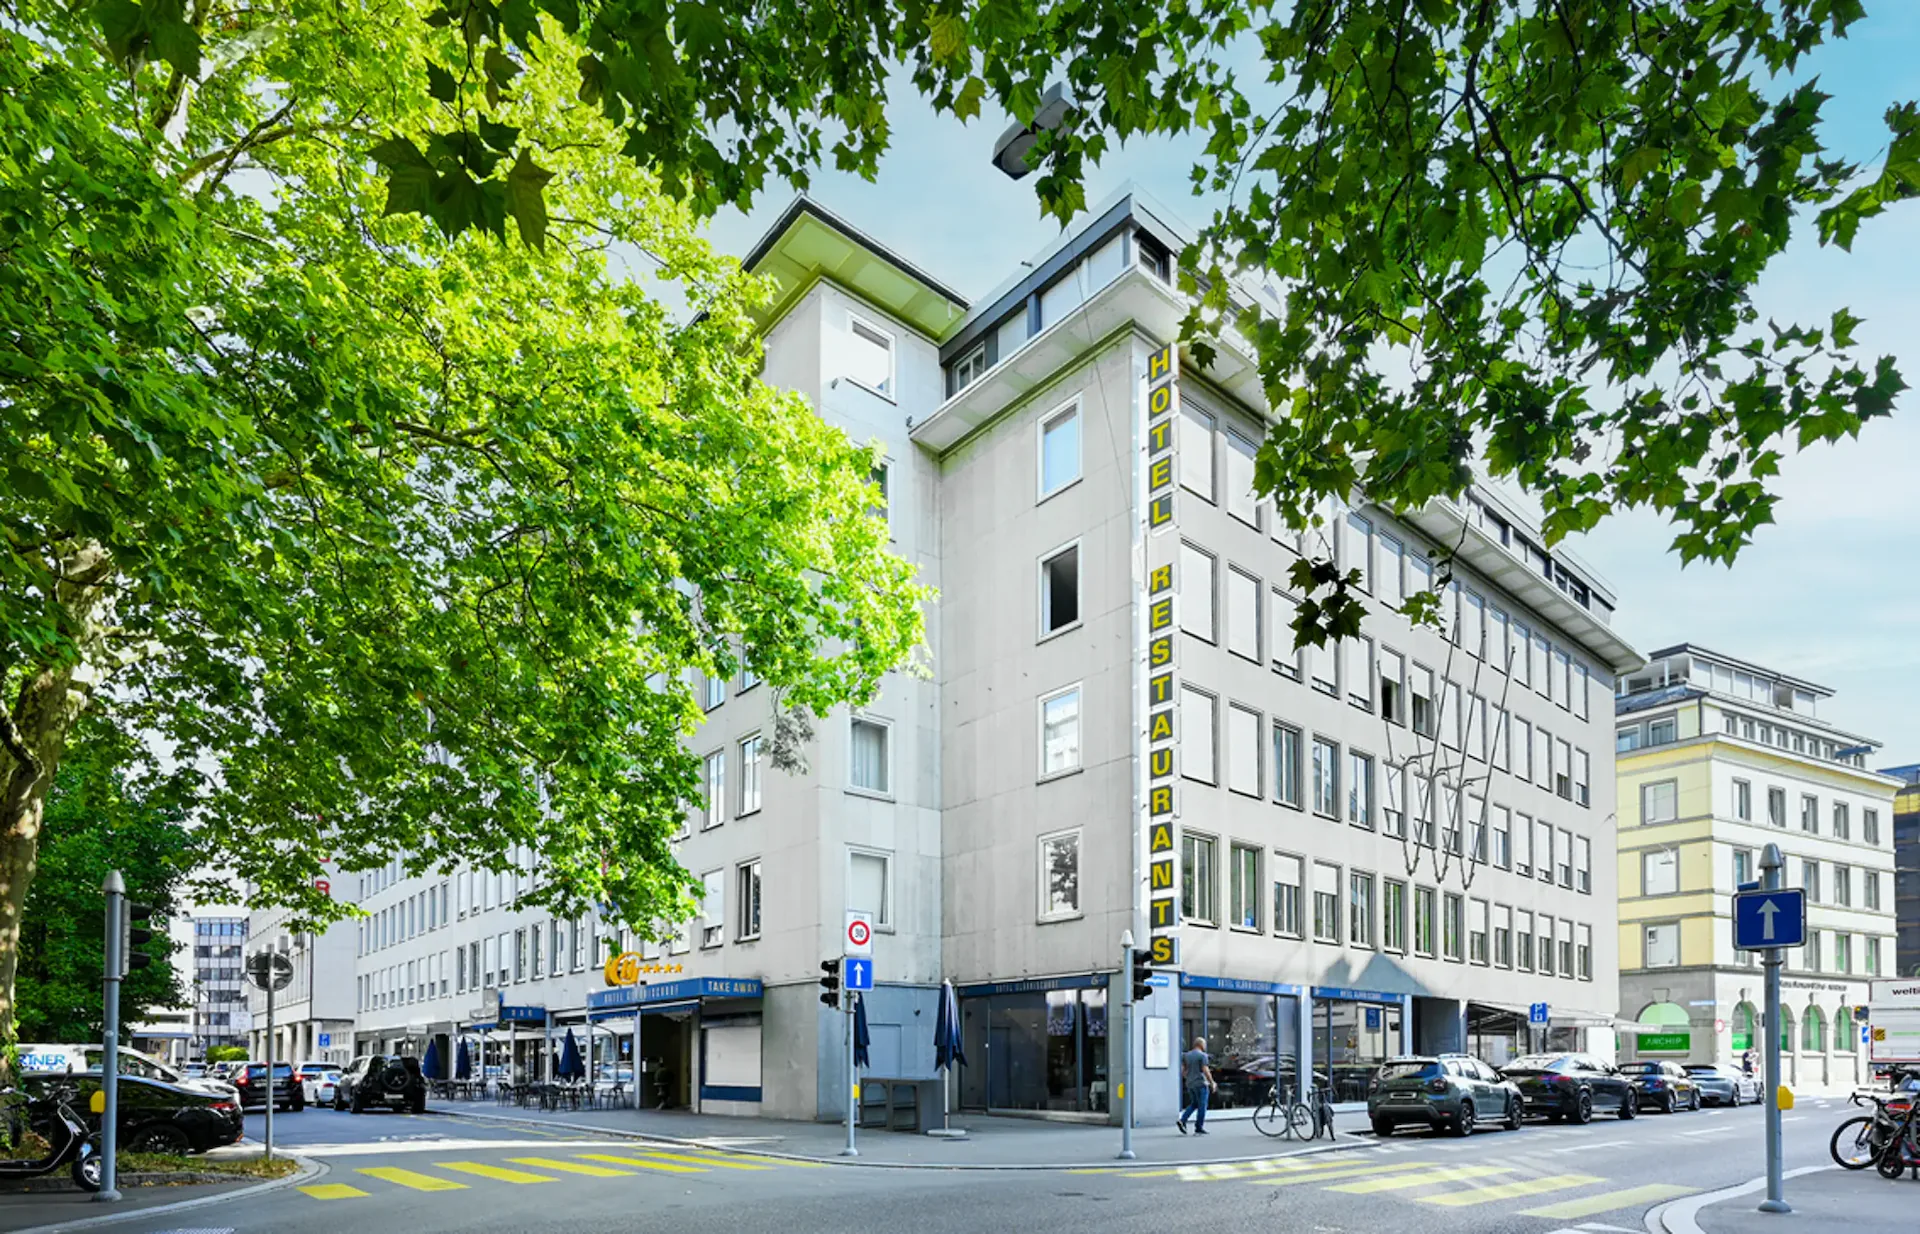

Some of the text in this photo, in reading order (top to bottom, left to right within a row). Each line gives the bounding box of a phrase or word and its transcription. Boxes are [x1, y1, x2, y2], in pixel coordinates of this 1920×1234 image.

[1150, 348, 1171, 525] HOTEL
[1151, 565, 1172, 963] RESTAURANTS
[707, 980, 758, 994] TAKE AWAY
